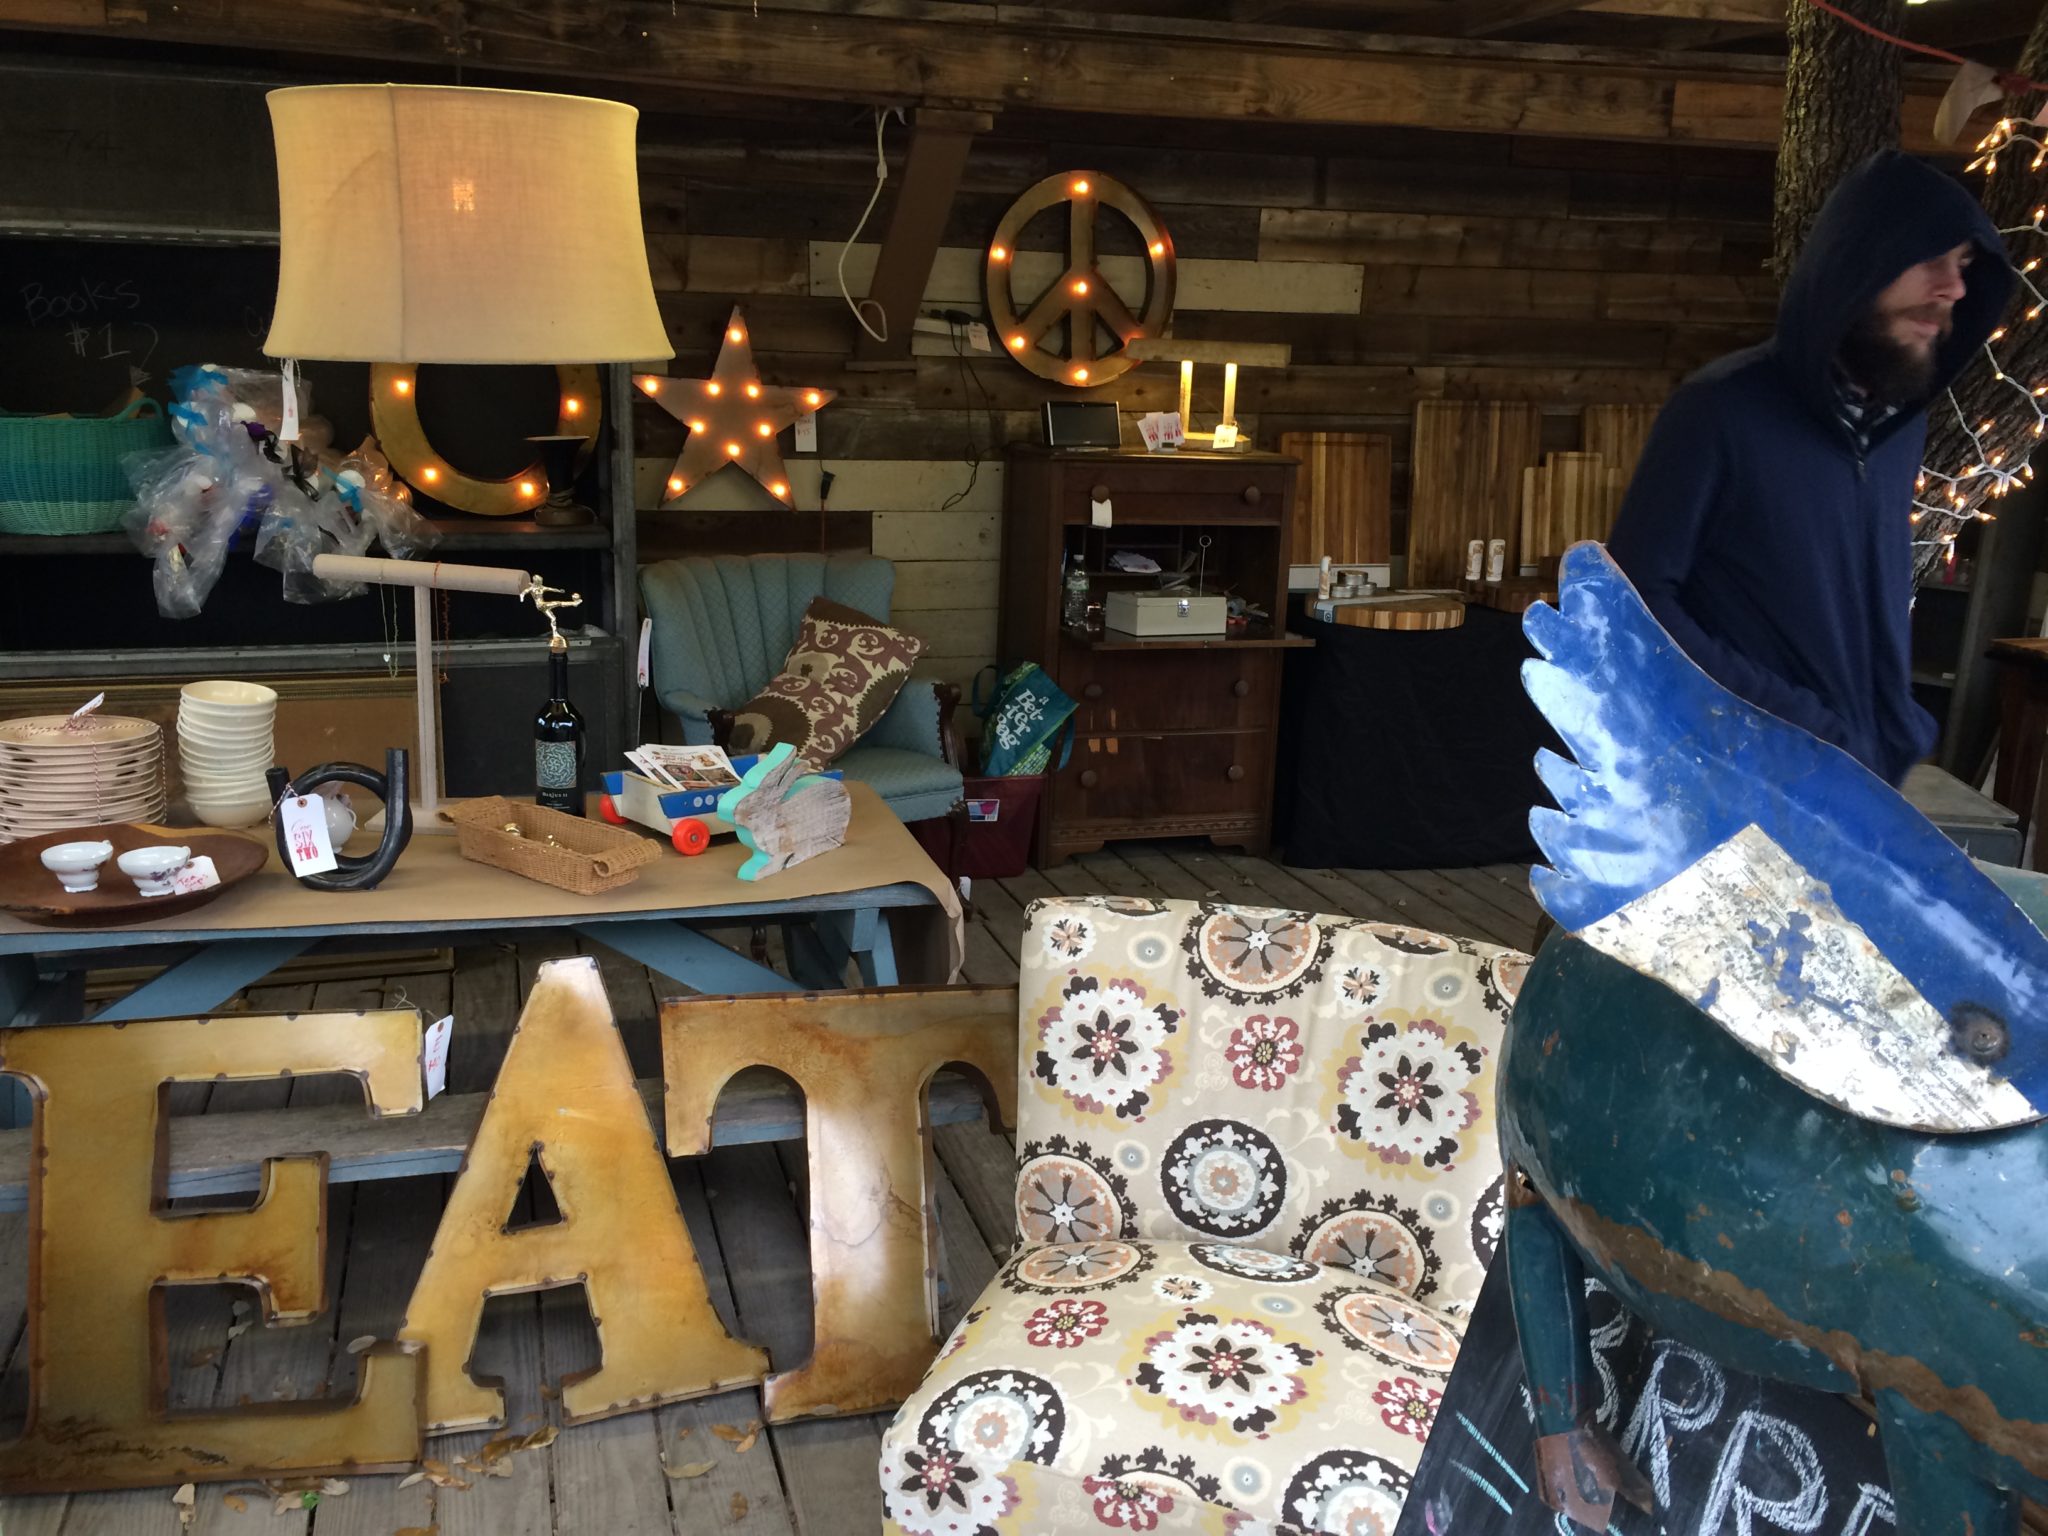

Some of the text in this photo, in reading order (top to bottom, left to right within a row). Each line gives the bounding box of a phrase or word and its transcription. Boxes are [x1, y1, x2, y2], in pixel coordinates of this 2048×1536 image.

[18, 276, 141, 328] Books
[293, 831, 313, 848] SIX
[296, 846, 319, 862] TWO
[0, 956, 1018, 1494] EAT
